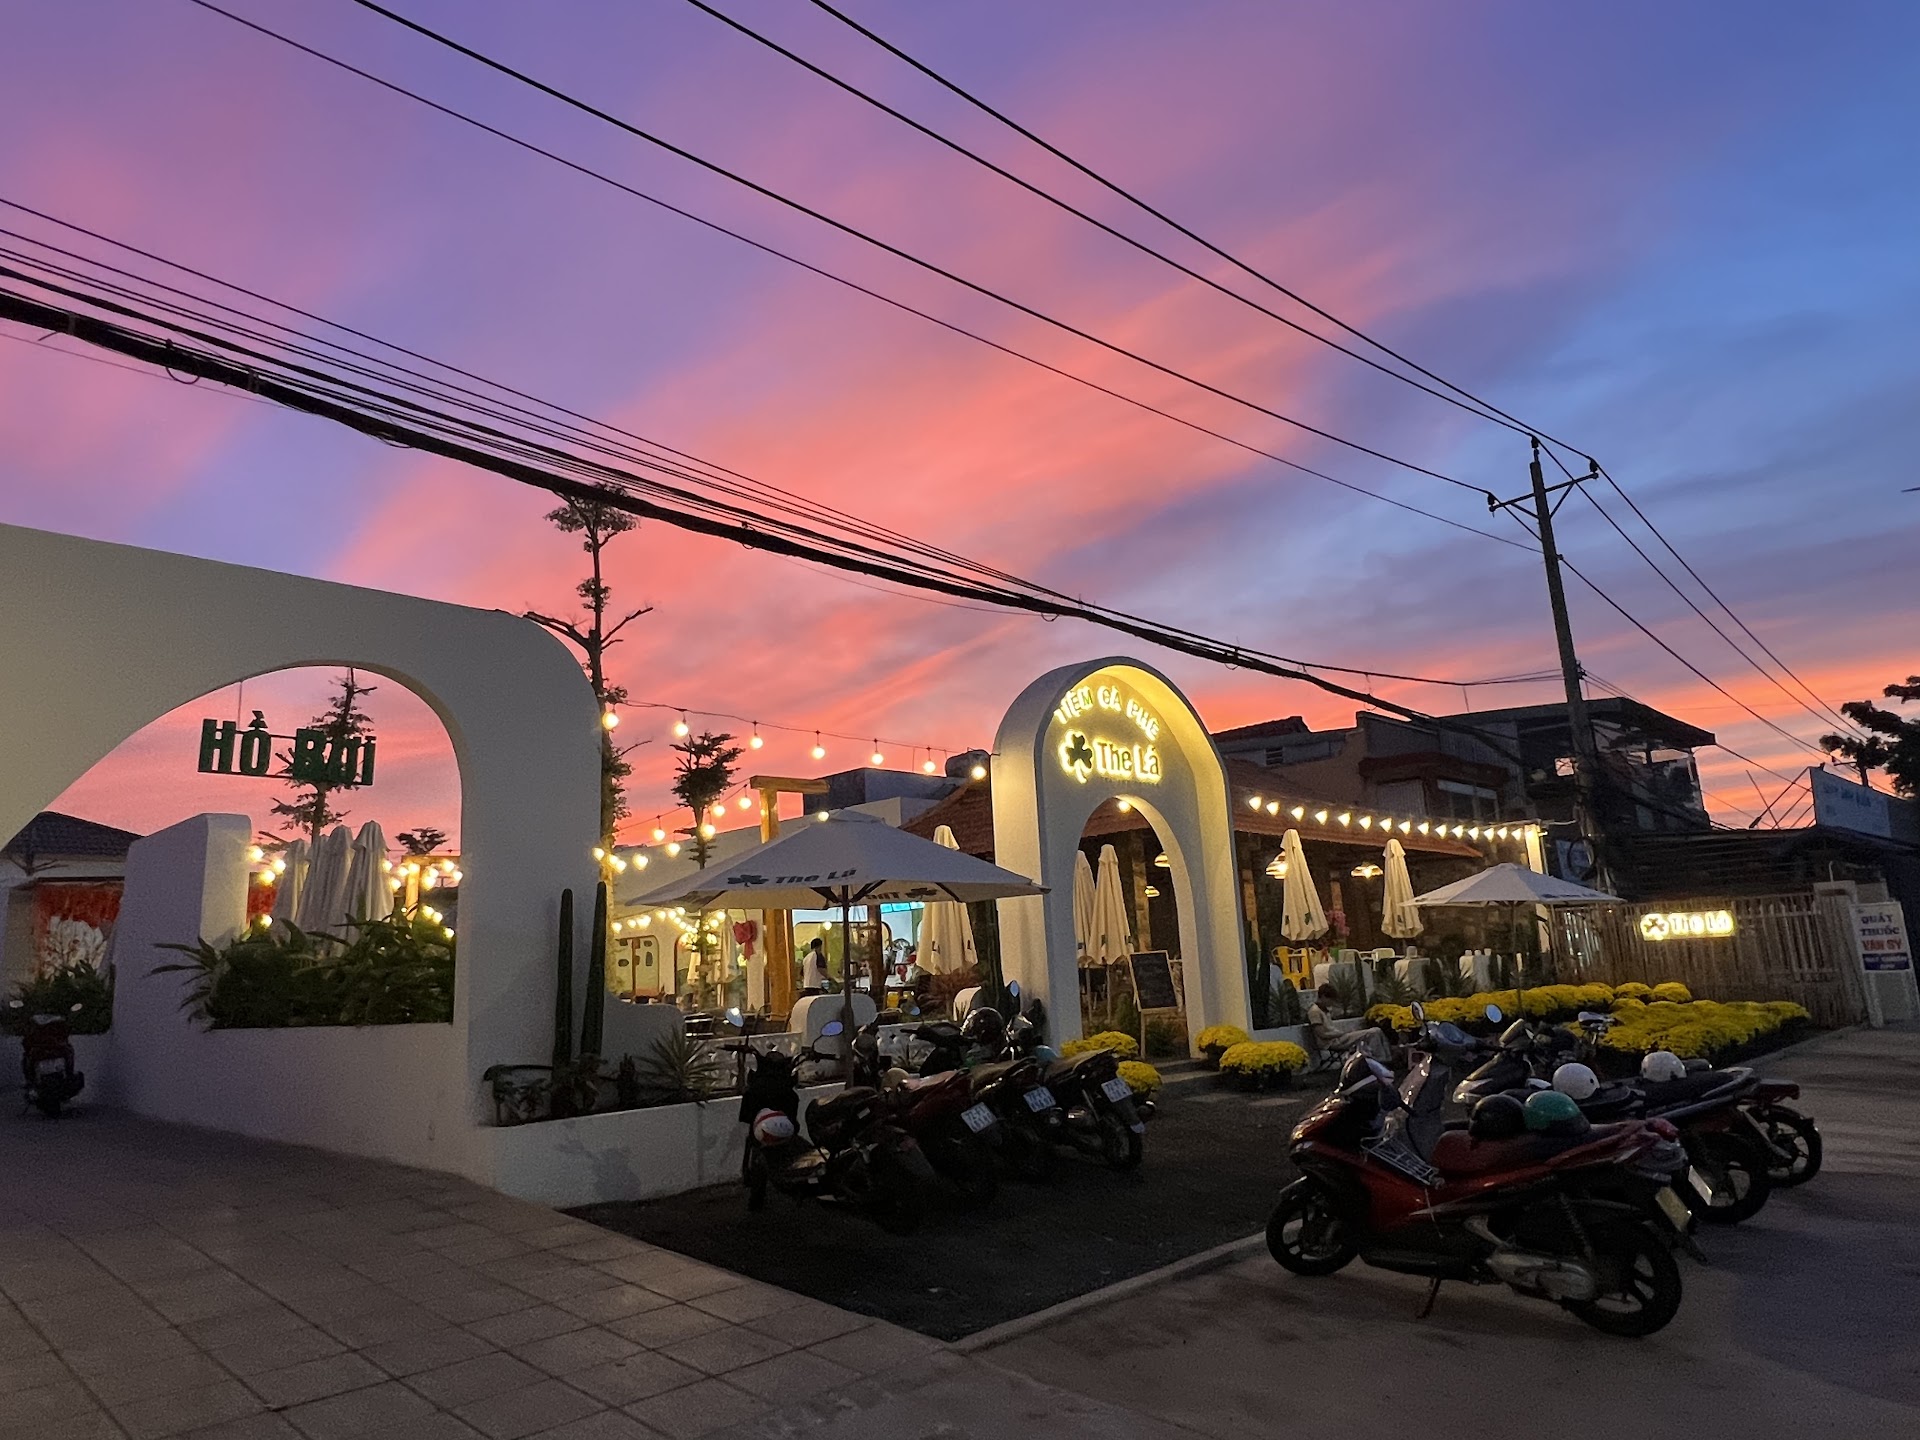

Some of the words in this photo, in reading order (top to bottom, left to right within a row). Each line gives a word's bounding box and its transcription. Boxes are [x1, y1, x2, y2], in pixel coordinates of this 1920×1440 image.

[198, 710, 271, 776] HỒ
[1093, 739, 1132, 775] The
[775, 874, 820, 884] The
